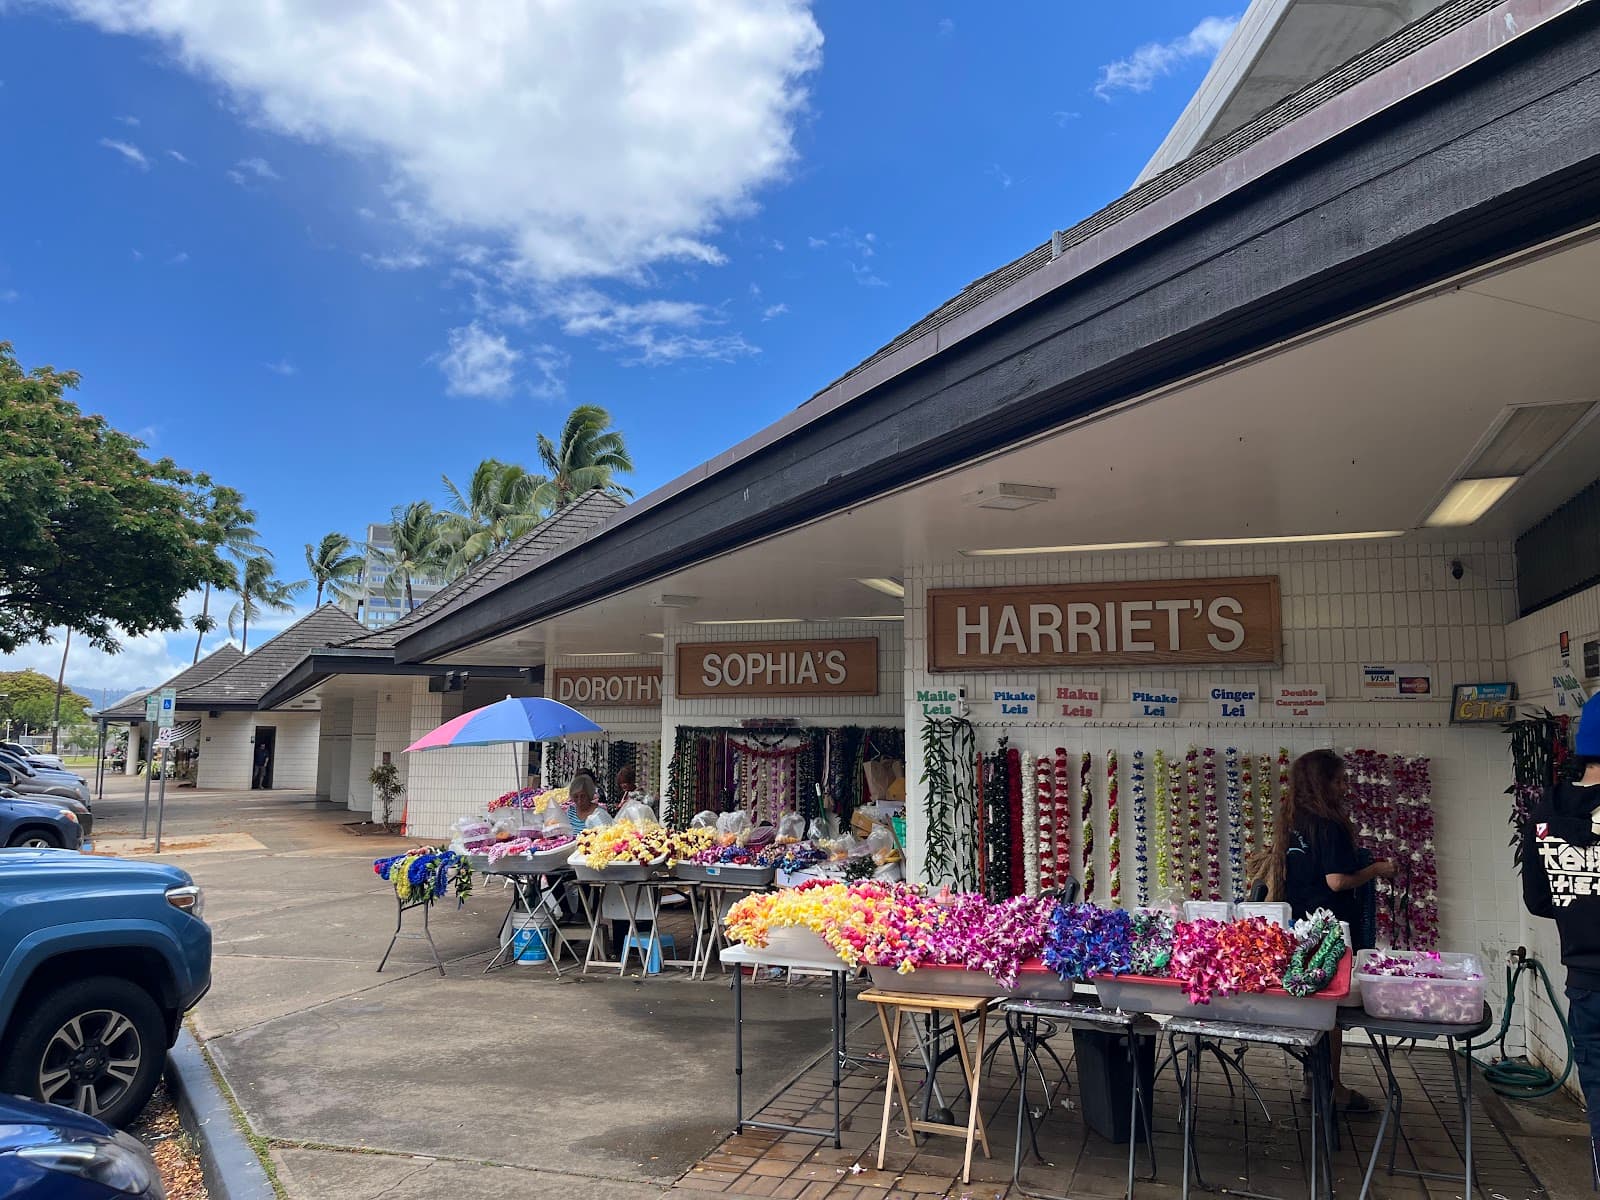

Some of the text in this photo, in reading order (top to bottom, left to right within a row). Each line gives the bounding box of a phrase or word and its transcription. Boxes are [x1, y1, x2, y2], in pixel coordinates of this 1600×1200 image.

[956, 596, 1246, 655] HARRIET'S
[702, 649, 847, 687] SOPHIA'S
[916, 690, 957, 702] Maile
[993, 691, 1036, 701] Pikake
[1056, 687, 1099, 701] Haku
[1132, 692, 1178, 704] Pikake
[1211, 688, 1256, 702] Ginger
[1281, 689, 1318, 697] Double
[922, 703, 952, 715] Leis
[1001, 703, 1029, 715] Leis
[1062, 704, 1093, 718] Leis
[1143, 705, 1165, 717] Lei
[1222, 704, 1245, 717] Lei
